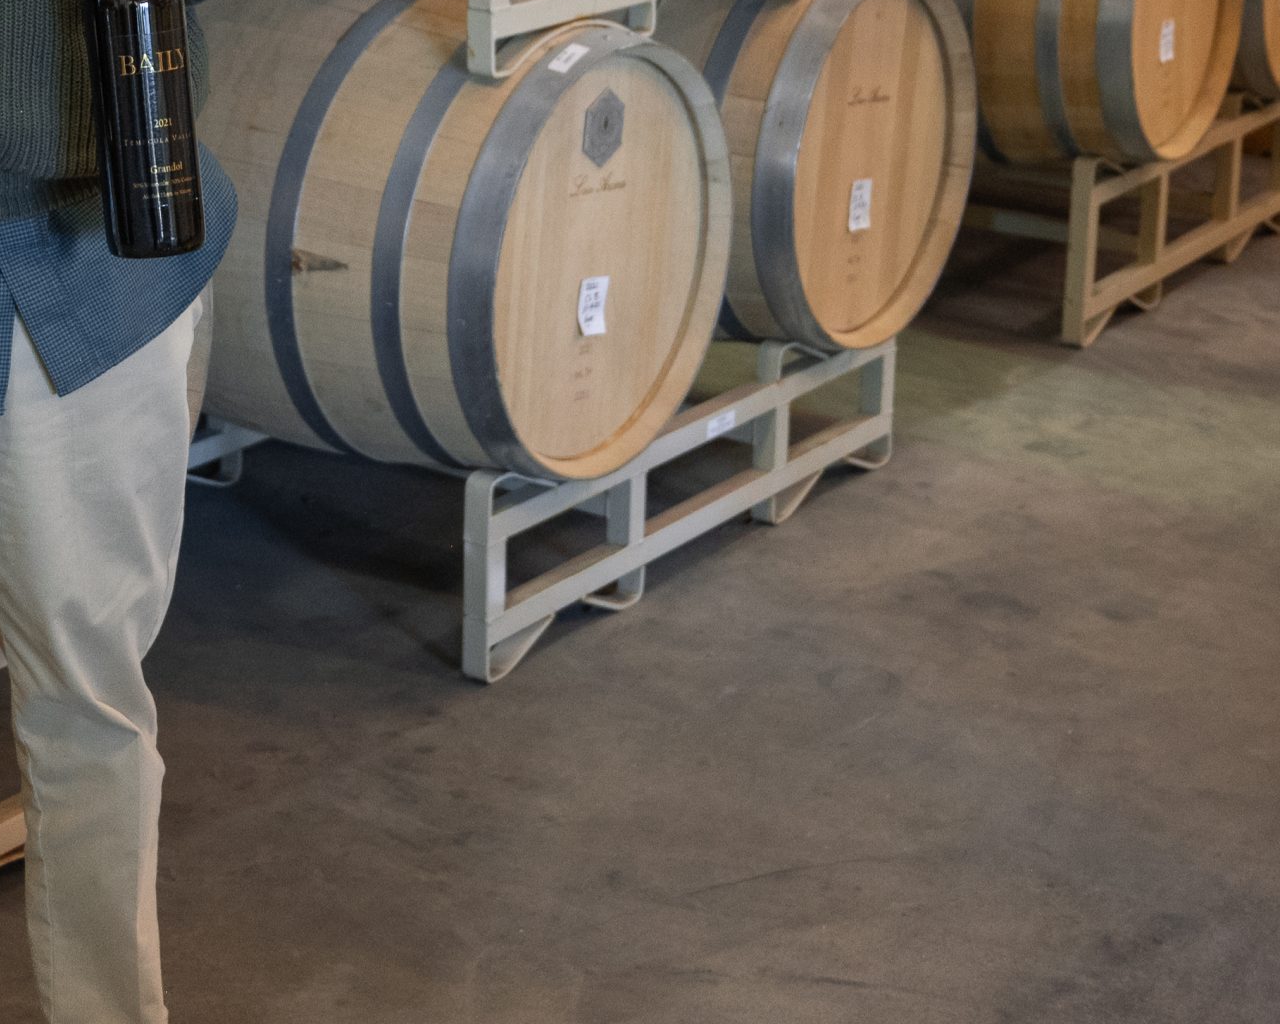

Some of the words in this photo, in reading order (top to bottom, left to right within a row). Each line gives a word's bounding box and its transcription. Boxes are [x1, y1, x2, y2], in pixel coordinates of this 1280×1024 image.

[153, 118, 173, 129] 2021
[124, 137, 169, 146] TEMCULA
[150, 161, 184, 174] Grandol
